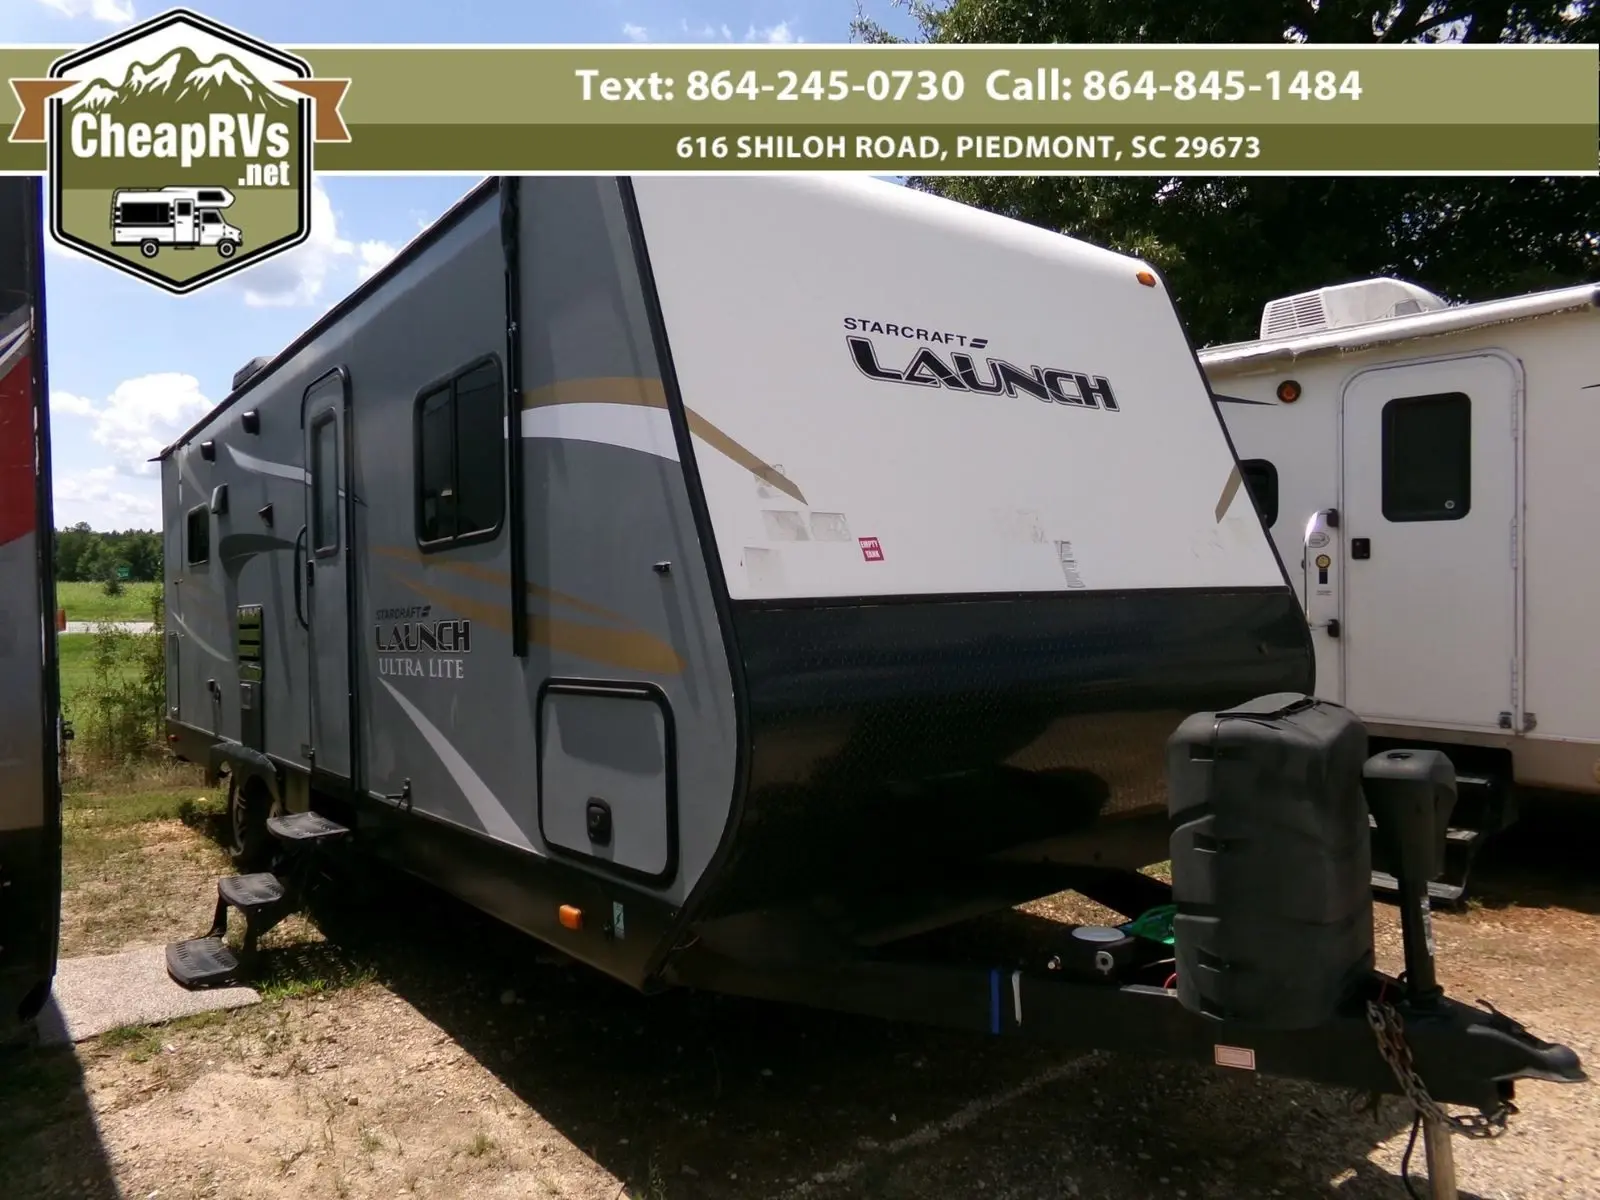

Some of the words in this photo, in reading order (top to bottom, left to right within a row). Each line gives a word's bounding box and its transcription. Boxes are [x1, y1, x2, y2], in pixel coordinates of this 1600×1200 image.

[843, 316, 968, 347] STARCRAFT
[845, 335, 1120, 412] LAUNCH
[376, 606, 422, 620] STARCRAFT
[374, 620, 472, 653] LAUNCH
[378, 657, 425, 676] ULTRA
[429, 659, 464, 679] LITE
